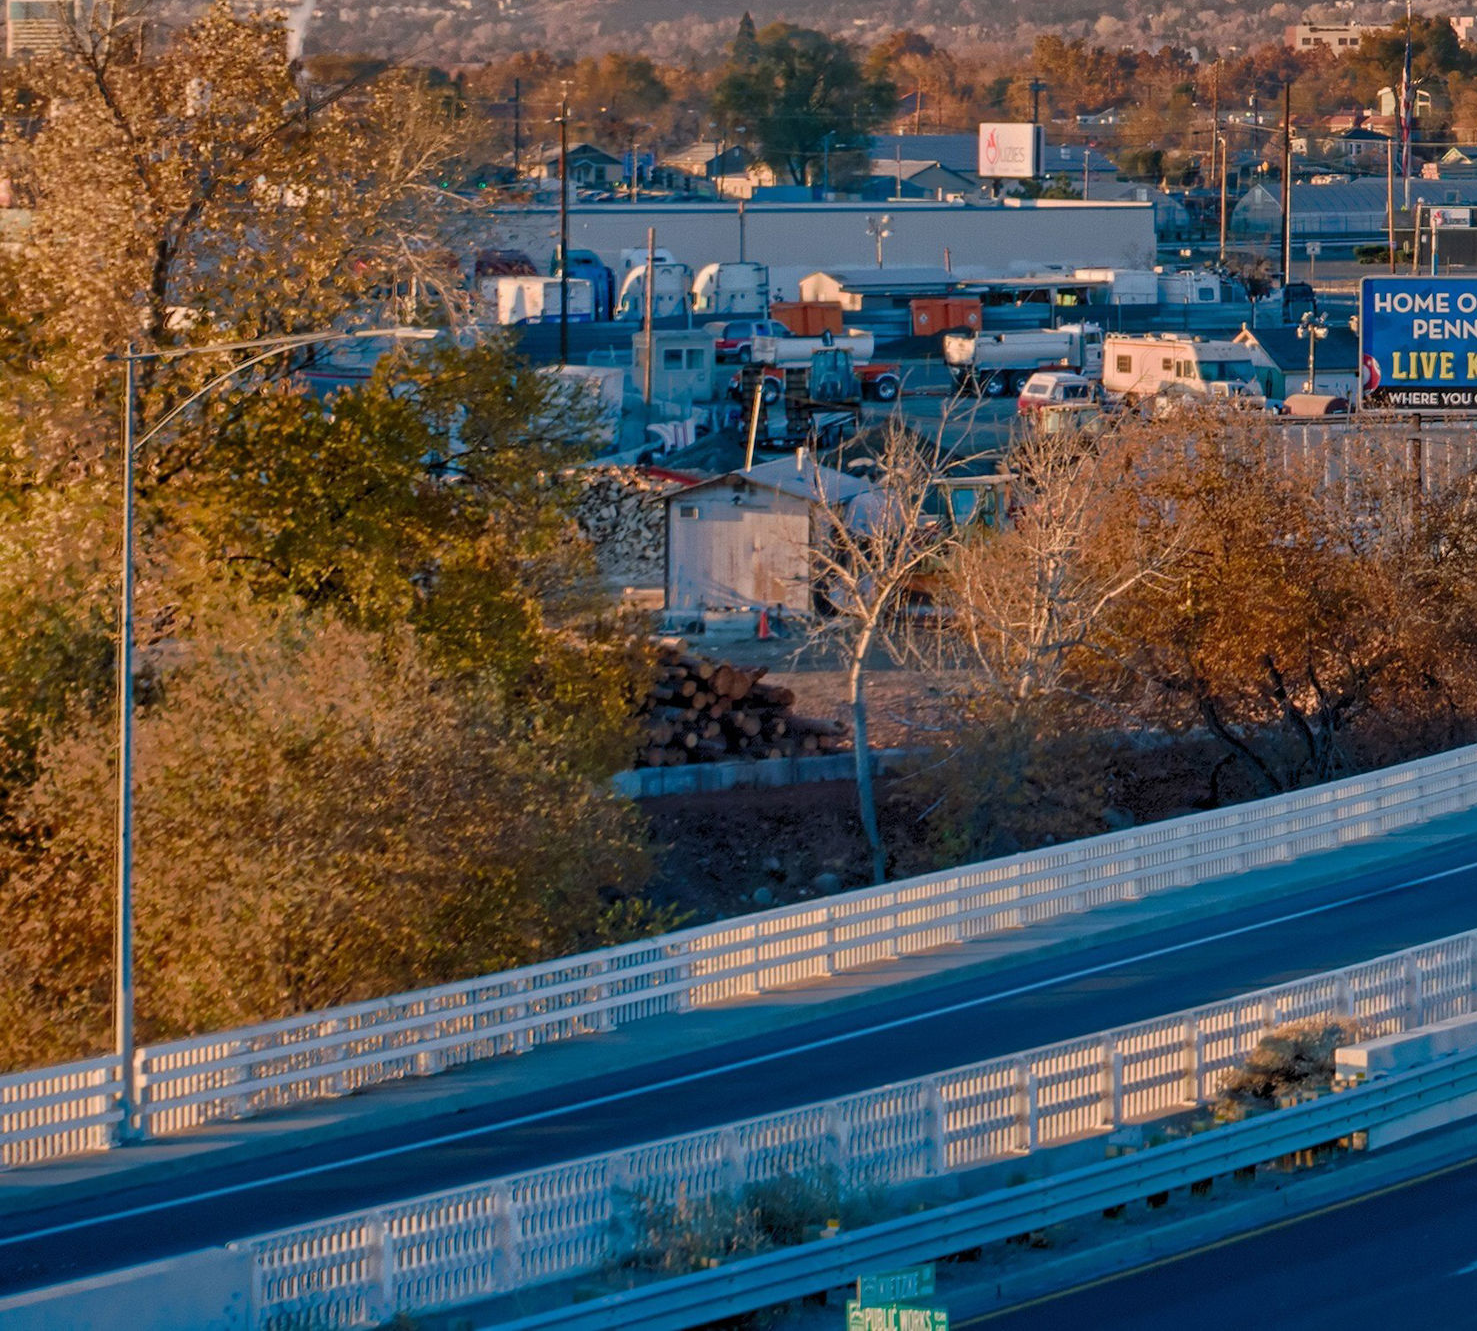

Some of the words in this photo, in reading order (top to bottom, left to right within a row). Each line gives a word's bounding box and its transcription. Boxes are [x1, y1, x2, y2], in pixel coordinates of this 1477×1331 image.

[1374, 292, 1450, 314] HOME
[1391, 351, 1455, 381] LIVE
[1388, 392, 1439, 407] WHERE
[1440, 392, 1471, 407] YOU
[864, 1307, 898, 1331] PUBLIC
[900, 1309, 932, 1331] WORKS
